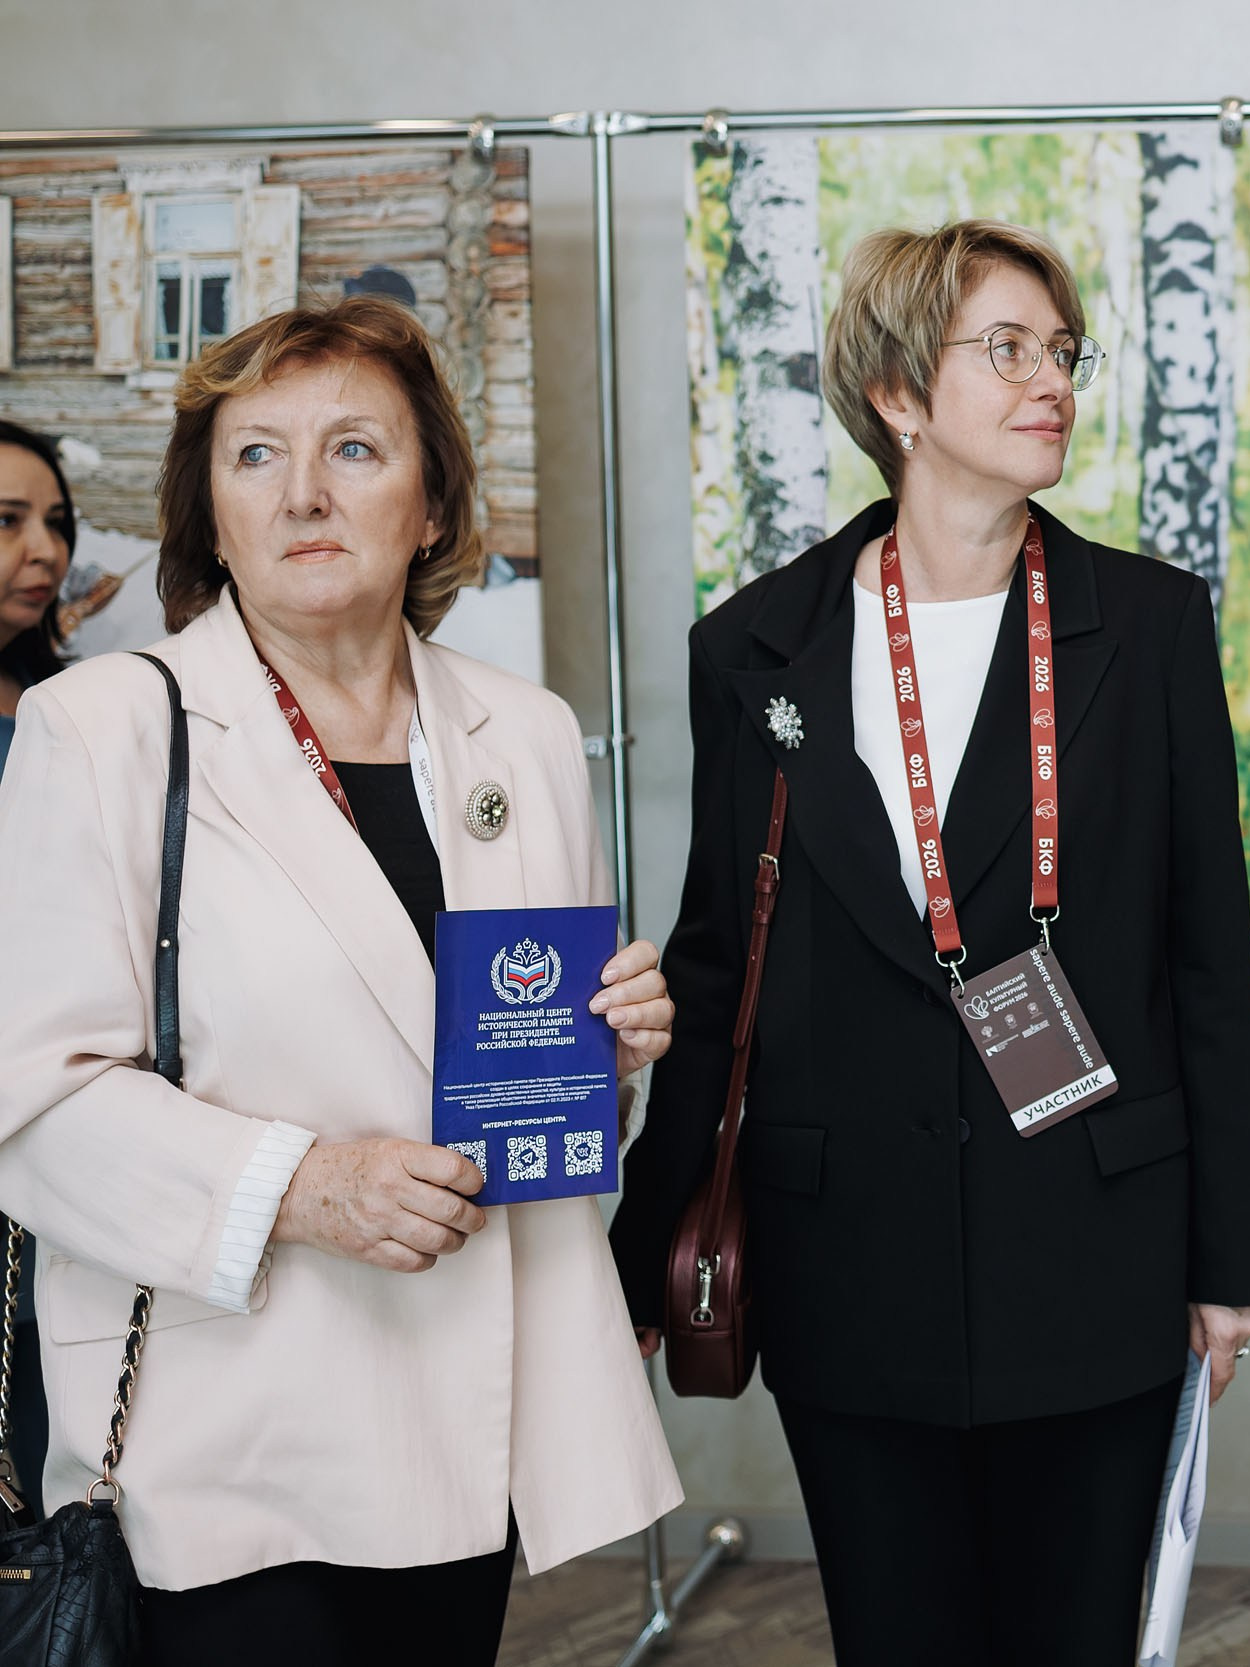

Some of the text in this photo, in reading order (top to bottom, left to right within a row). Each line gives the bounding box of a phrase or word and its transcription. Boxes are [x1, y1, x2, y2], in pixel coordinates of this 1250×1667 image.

[886, 584, 942, 879] 2026 БКФ 2026 БКФ
[1031, 570, 1054, 876] БКФ 2026 БКФ БКФ
[300, 738, 326, 778] 2026
[986, 972, 1026, 997] БАЛТИЙСКИЙ
[989, 981, 1028, 1004] КУЛЬТУРНЫЙ
[994, 992, 1028, 1012] ФОРУМ 2026
[1030, 949, 1094, 1070] sapere aude sapere aude
[478, 1018, 573, 1031] ИСТОРИЧЕСКОЙ ПАМЯТИ
[480, 1008, 572, 1021] НАЦИОНАЛЬНЫЙ ЦЕНТР
[476, 1036, 576, 1050] РОССИЙСКОЙ ФЕДЕРАЦИИ
[492, 1028, 560, 1040] ПРИ ПРЕЗИДЕНТЕ
[1024, 1074, 1102, 1120] УЧАСТНИК
[482, 1116, 566, 1130] ИНТЕРНЕТ-РЕСУРСЫ ЦЕНТРА
